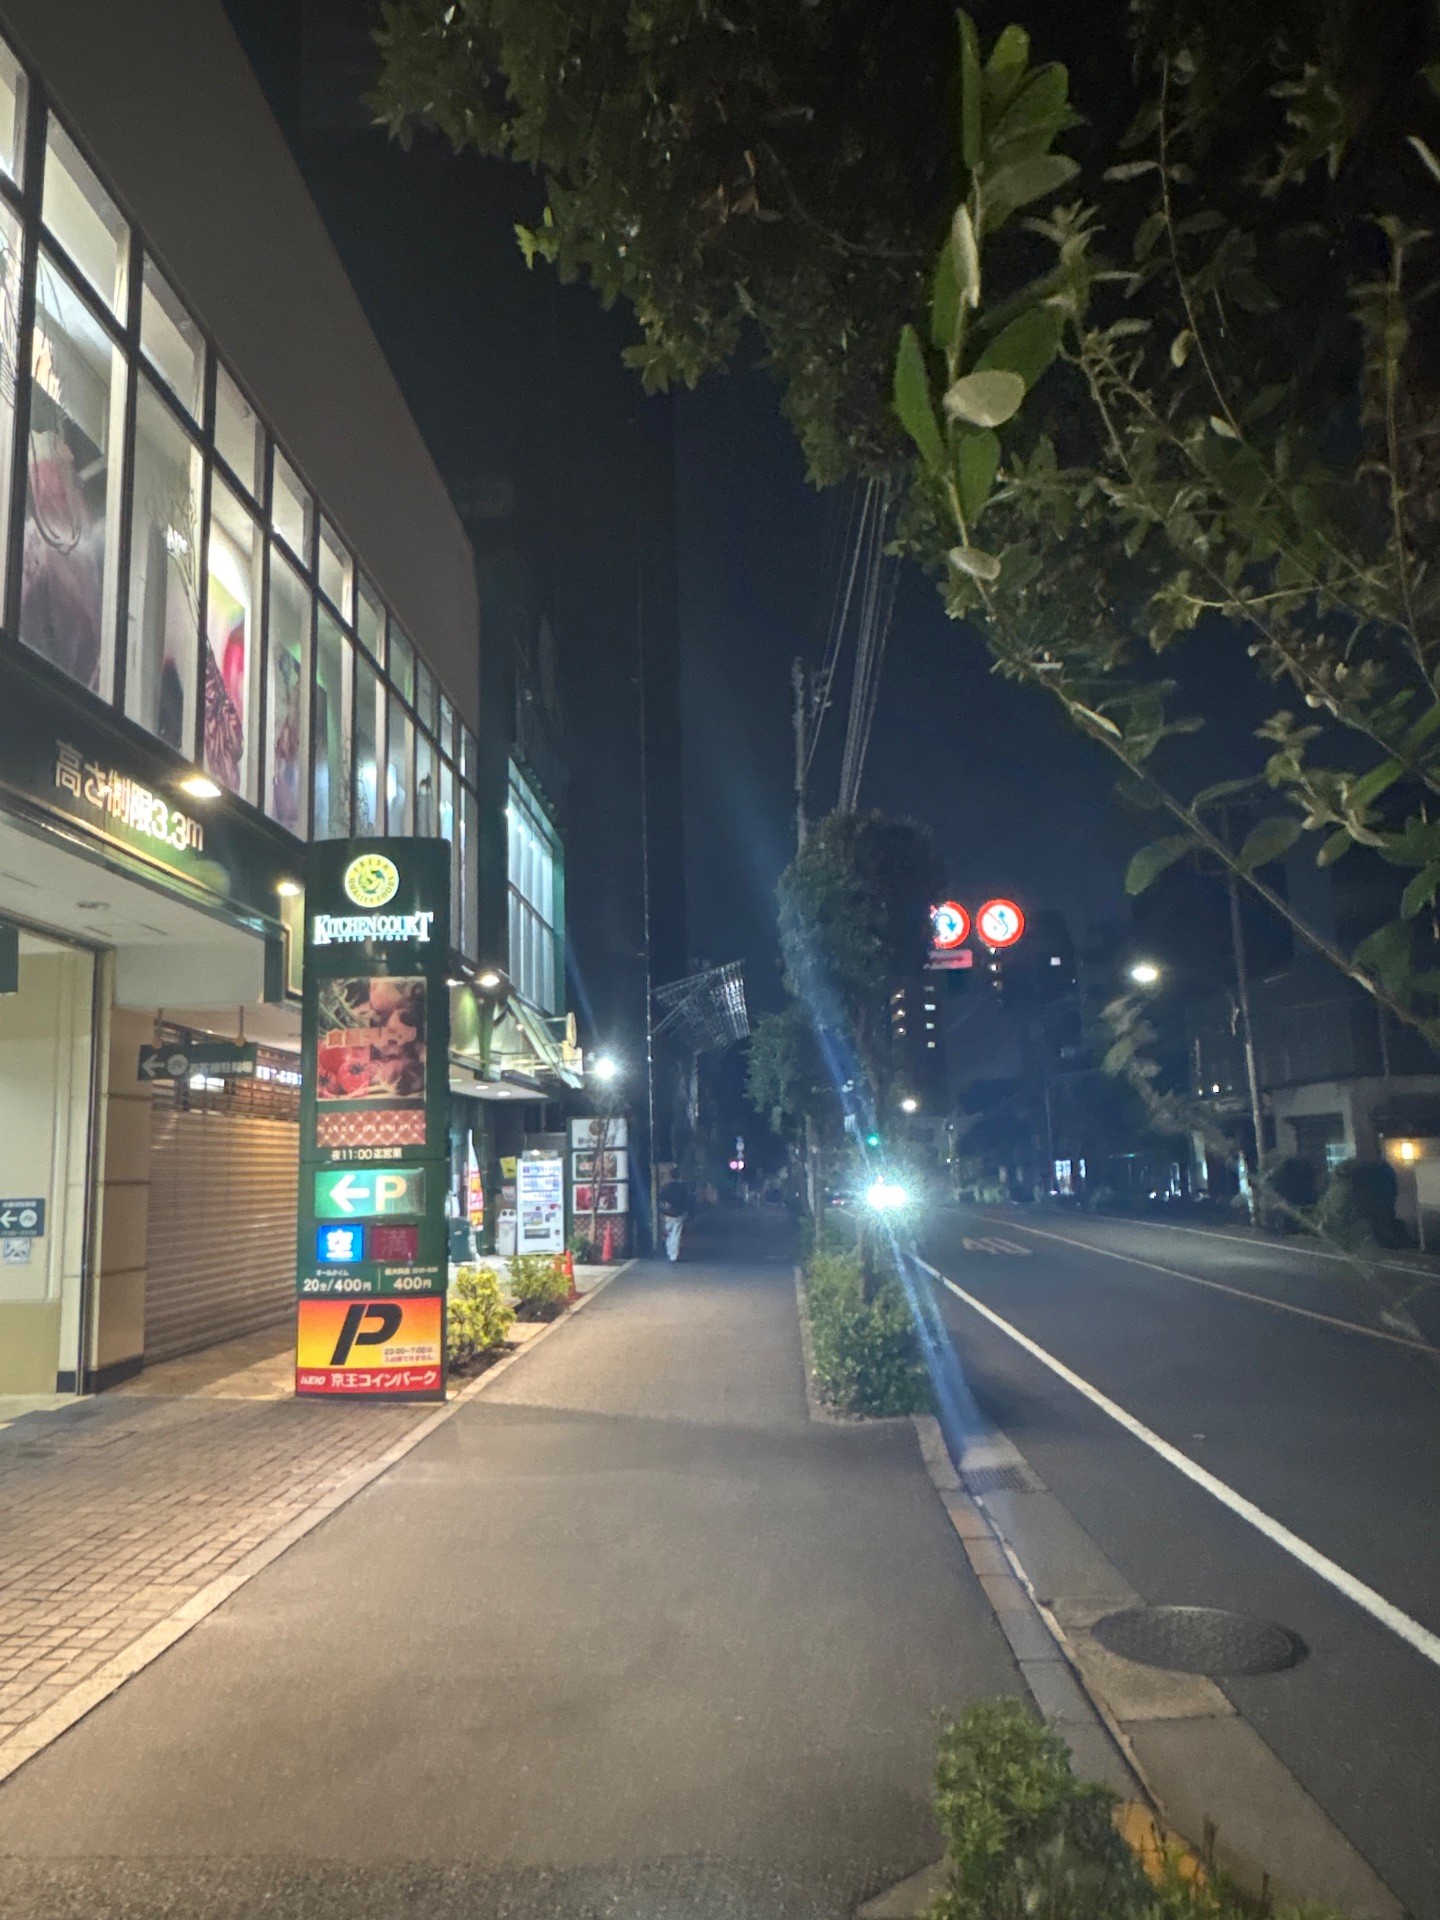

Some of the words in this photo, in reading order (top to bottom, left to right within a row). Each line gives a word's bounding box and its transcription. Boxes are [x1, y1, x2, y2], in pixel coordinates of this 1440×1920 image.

[55, 739, 203, 851] 高さ制限3.3m
[375, 1175, 407, 1212] P
[326, 1229, 354, 1258] 空
[393, 1276, 432, 1290] 400円
[330, 1303, 404, 1366] P
[331, 1370, 437, 1388] 京王コインパーク
